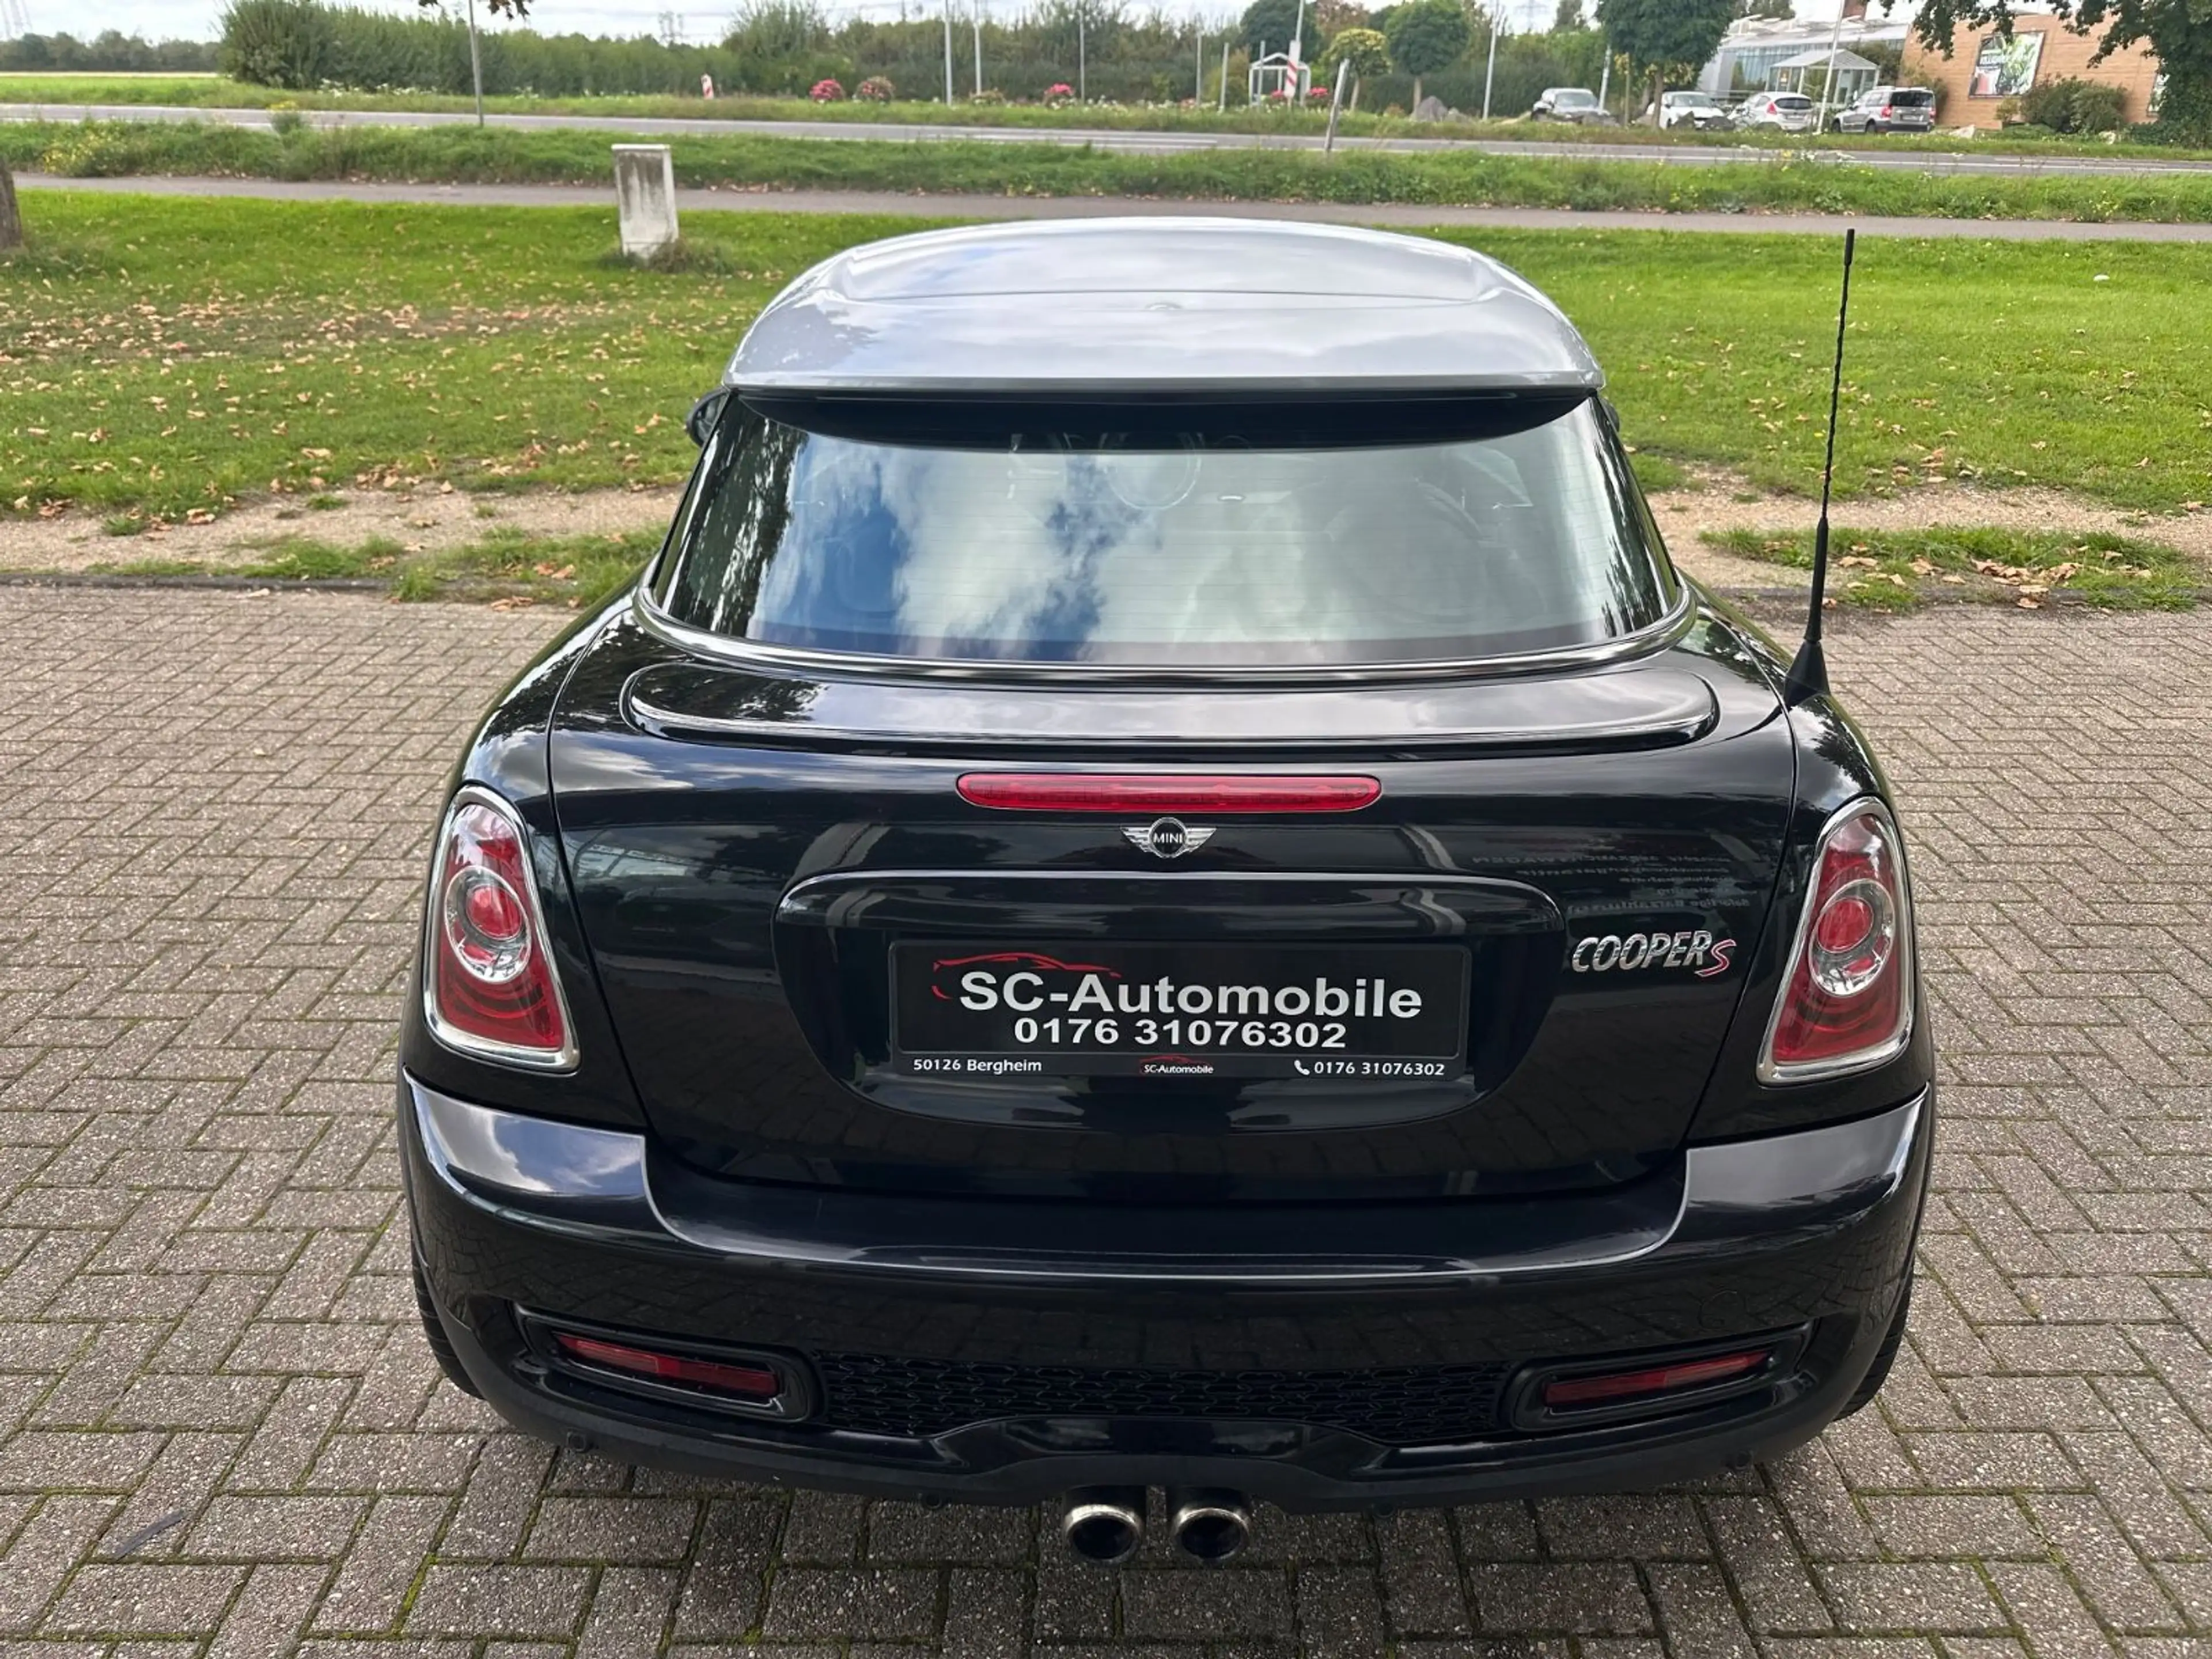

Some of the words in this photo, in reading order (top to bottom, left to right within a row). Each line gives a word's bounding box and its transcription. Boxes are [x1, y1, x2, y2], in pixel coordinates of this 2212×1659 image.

[1153, 832, 1183, 844] MINI
[1571, 930, 1713, 972] COOPER
[959, 971, 1423, 1018] SC-Automobile
[1014, 1017, 1119, 1044] 0176
[1134, 1018, 1347, 1048] 31076302
[913, 1059, 961, 1071] 50126
[967, 1059, 1043, 1076] Bergheim
[1143, 1063, 1214, 1074] SC-Automobile
[1313, 1062, 1356, 1074] 0176
[1361, 1062, 1445, 1076] 31076302
